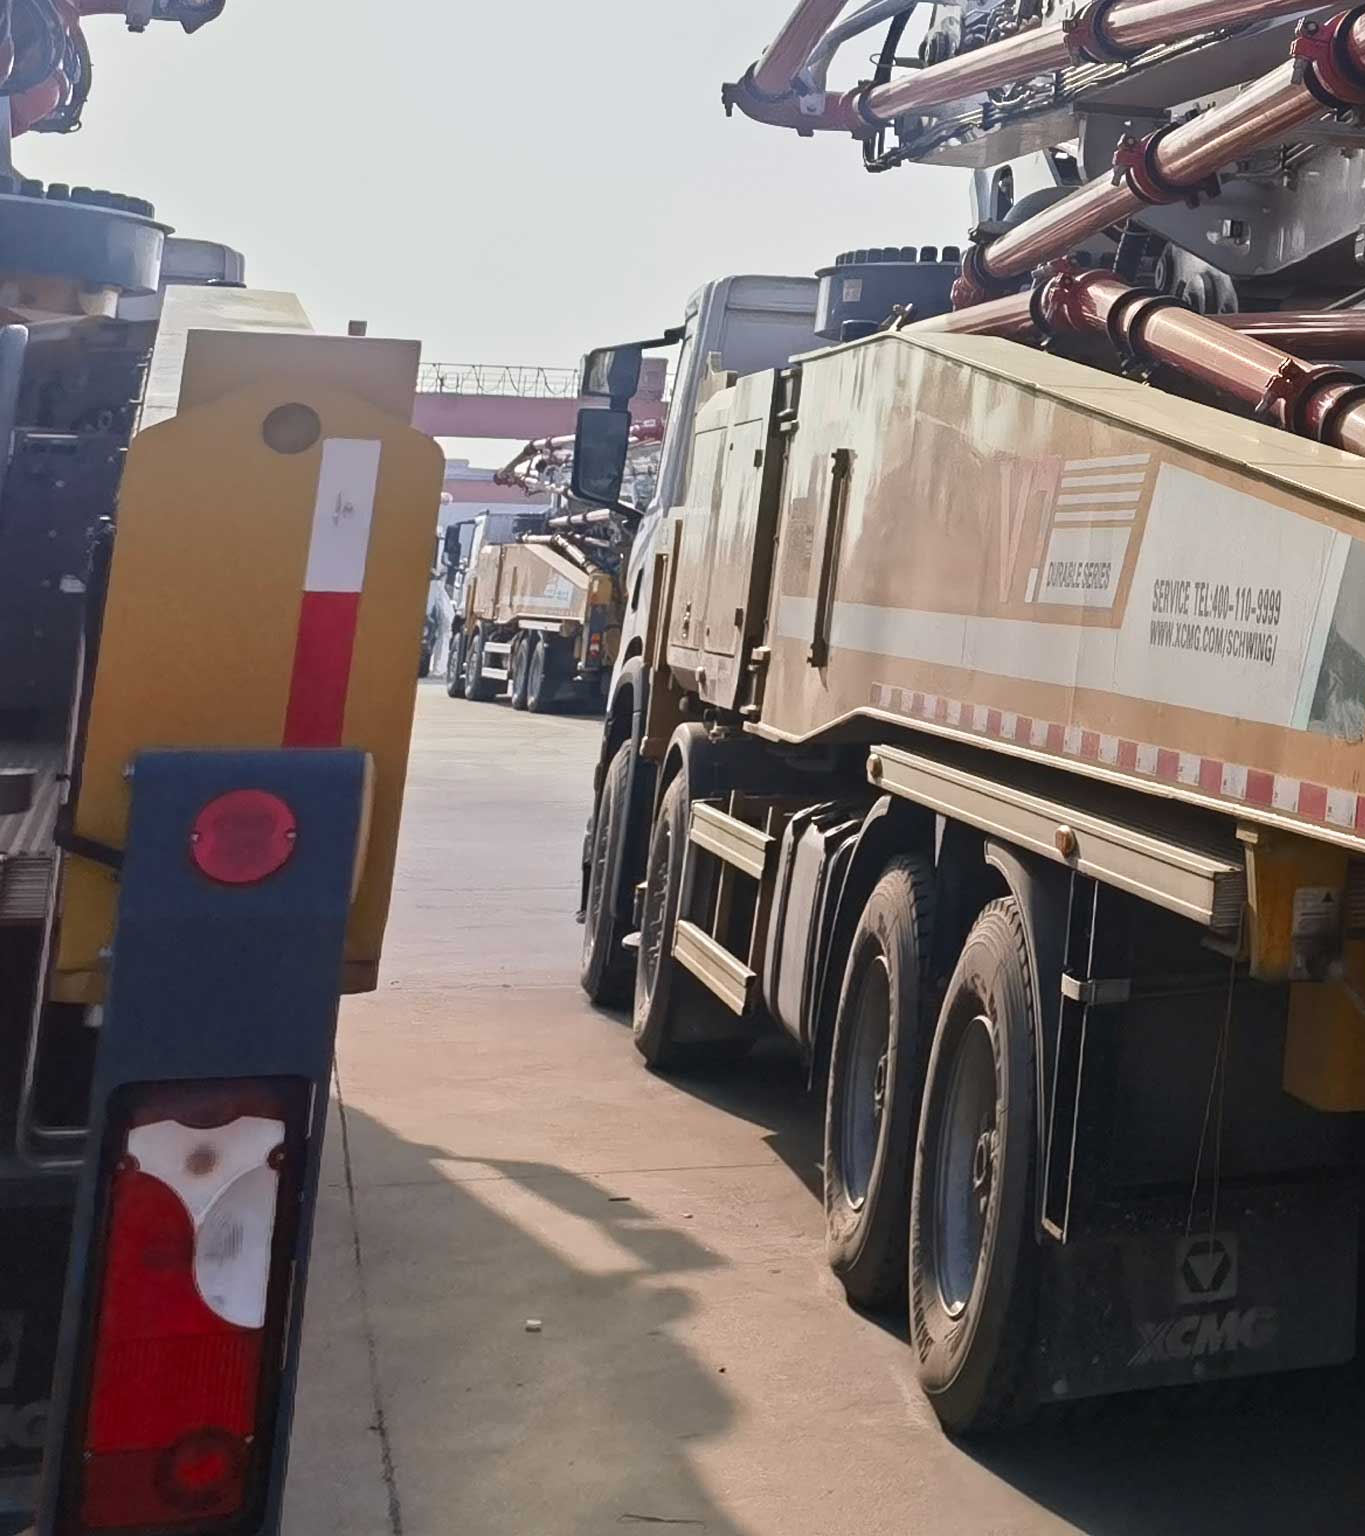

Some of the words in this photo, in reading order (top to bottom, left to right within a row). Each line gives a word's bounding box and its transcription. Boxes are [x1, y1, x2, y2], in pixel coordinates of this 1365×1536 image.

[1046, 560, 1084, 588] DURABLE
[1081, 561, 1112, 590] SERIES
[1152, 578, 1191, 614] SERVICE
[1194, 581, 1281, 626] TEL:400-110-9999
[1149, 620, 1278, 666] WWW.XCMG.COM/SCHWING/
[1127, 1306, 1281, 1368] XCMG
